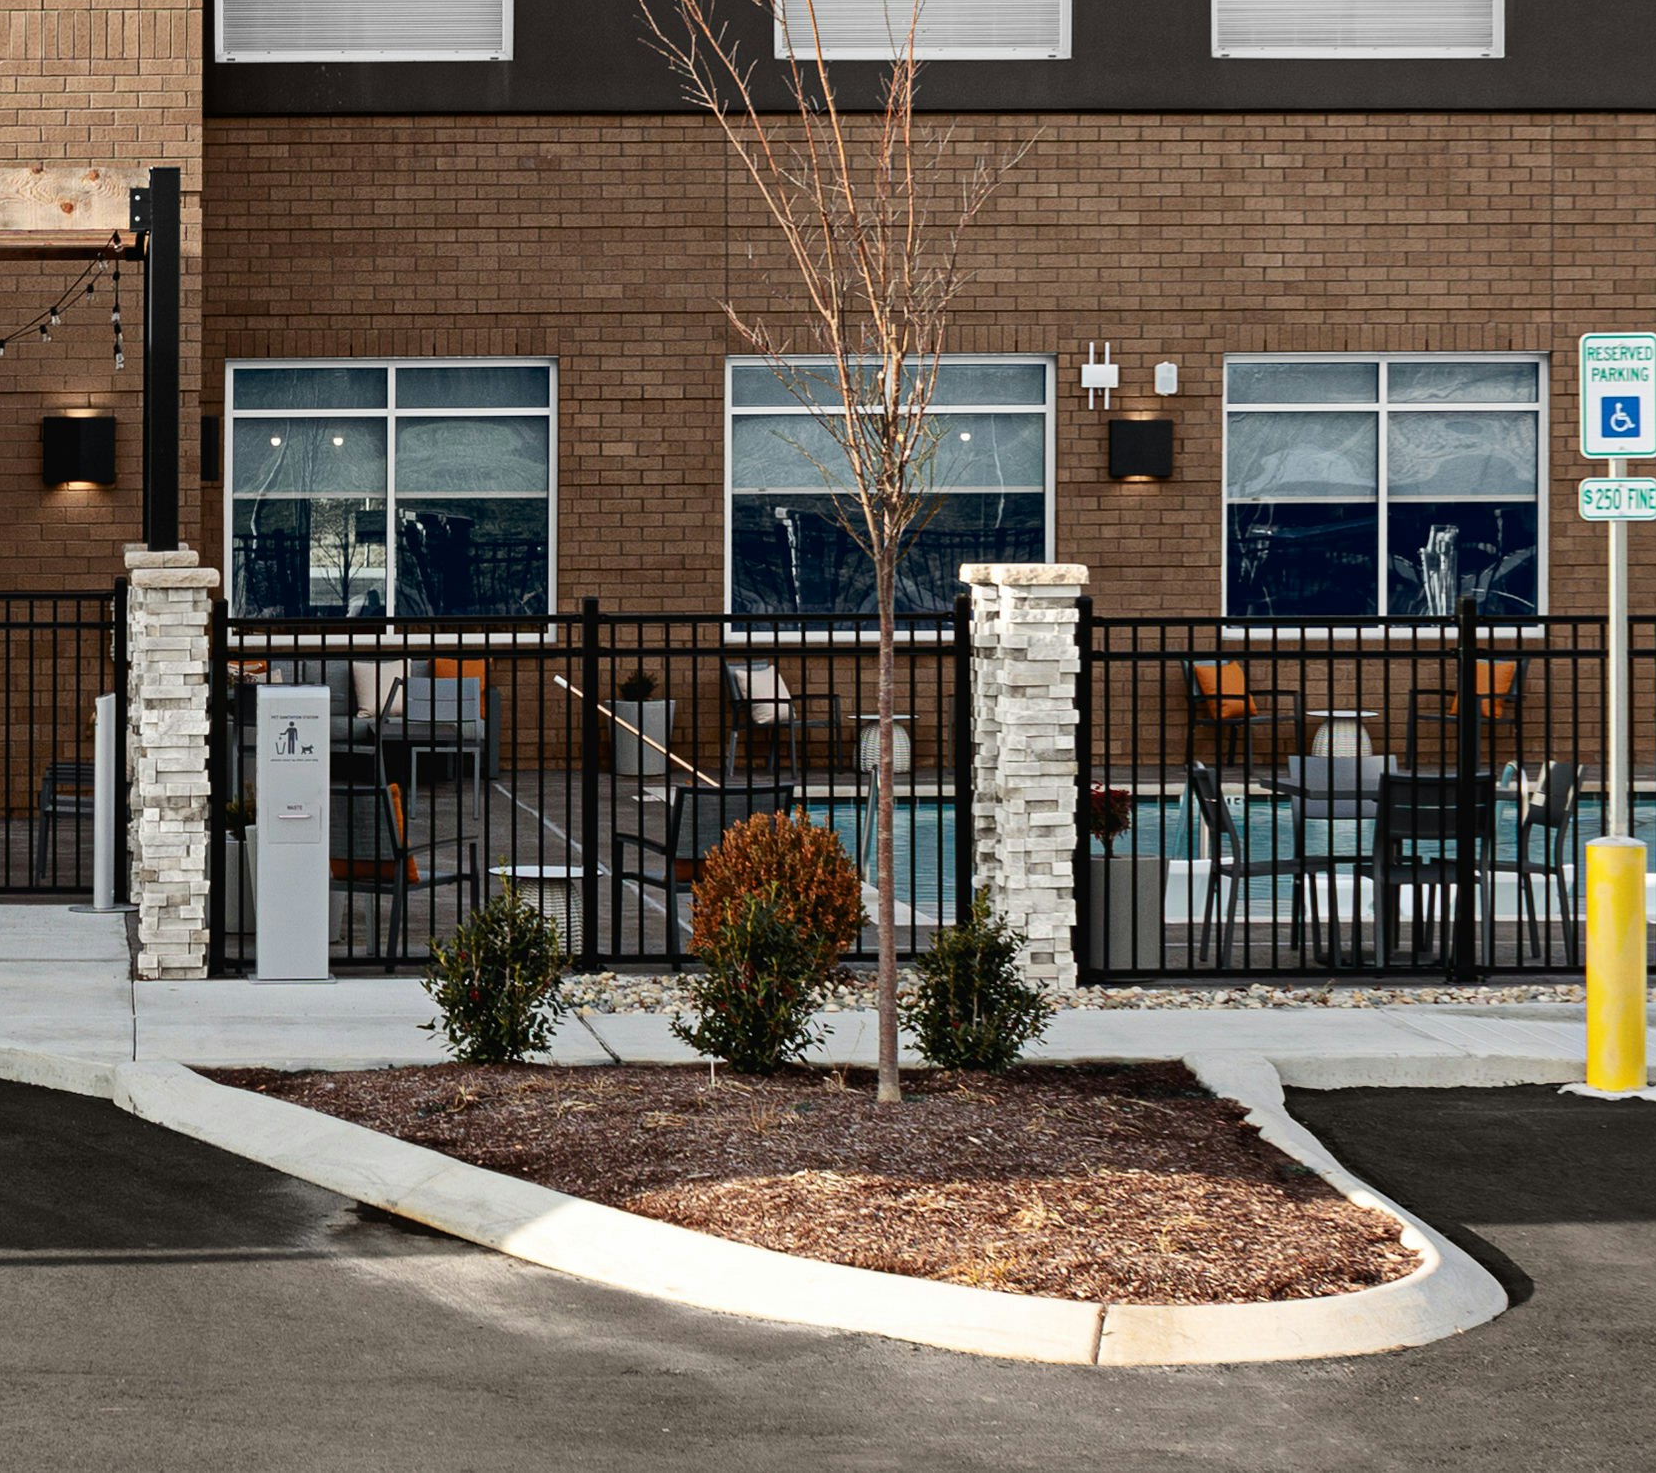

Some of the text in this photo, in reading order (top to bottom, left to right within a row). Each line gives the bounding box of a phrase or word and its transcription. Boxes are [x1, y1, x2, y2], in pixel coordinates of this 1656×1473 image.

[1587, 346, 1654, 361] RESERVED
[1591, 367, 1650, 382] PARKING
[1627, 488, 1656, 510] FINE
